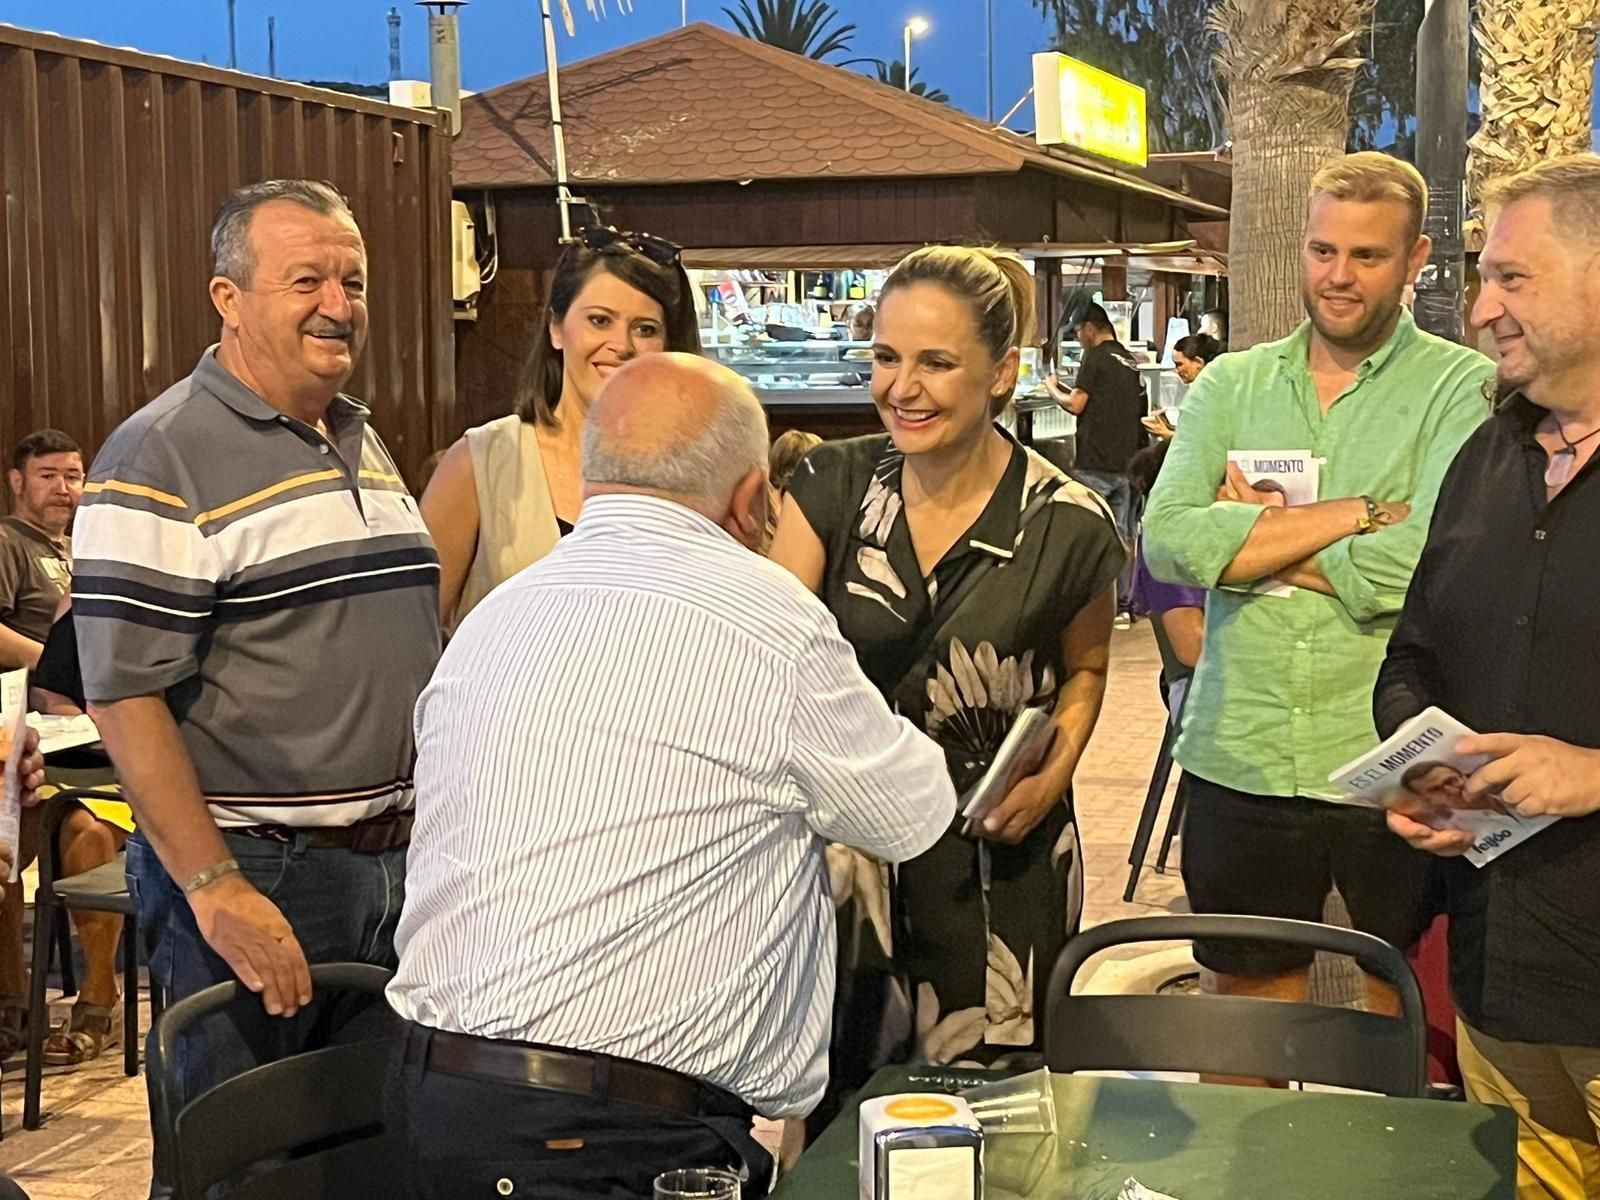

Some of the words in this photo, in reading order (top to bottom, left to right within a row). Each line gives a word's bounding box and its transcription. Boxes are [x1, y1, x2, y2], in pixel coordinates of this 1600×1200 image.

[1253, 459, 1304, 474] MOMENTO
[1349, 775, 1372, 790] ES
[1364, 767, 1389, 781] EL
[1379, 726, 1445, 772] MOMENTO
